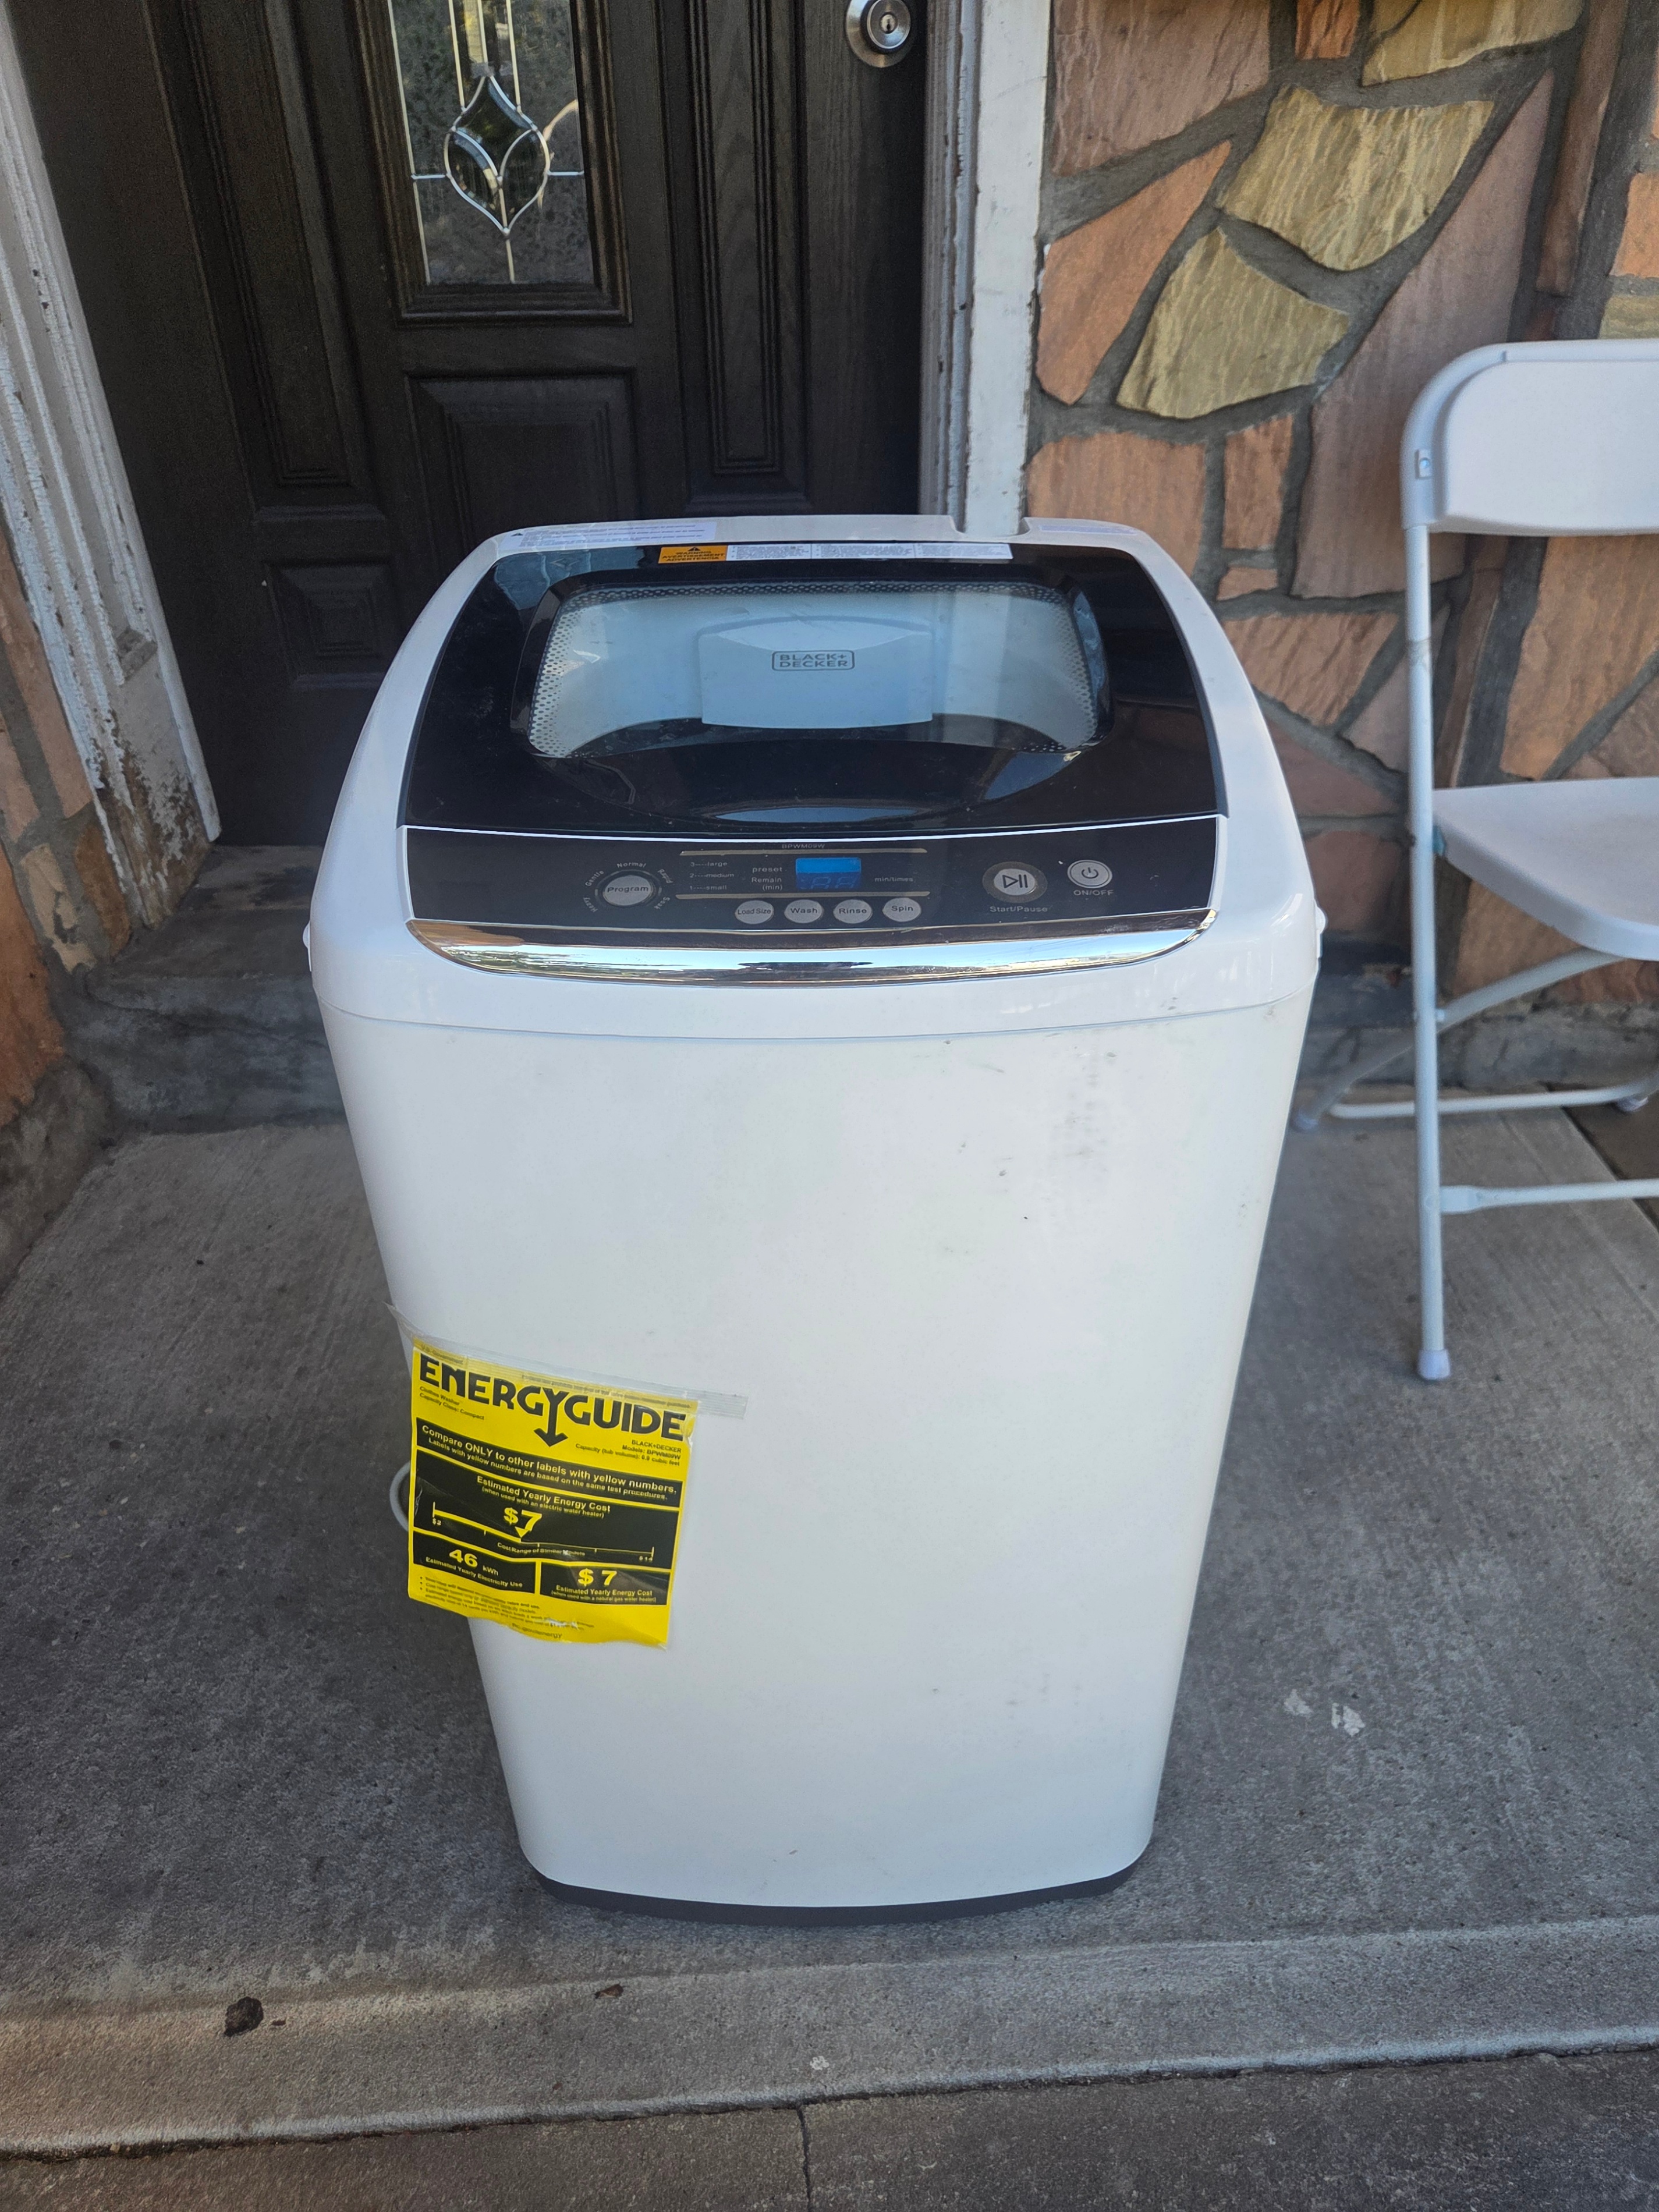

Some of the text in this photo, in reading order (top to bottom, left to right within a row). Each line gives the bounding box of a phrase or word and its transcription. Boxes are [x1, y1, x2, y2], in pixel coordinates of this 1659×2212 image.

[779, 653, 847, 661] BLACK+
[585, 870, 604, 887] Gentle
[654, 896, 670, 909] Soak
[420, 1353, 686, 1446] ENERGYGUIDE
[422, 1425, 463, 1448] Compare
[465, 1442, 493, 1456] ONLY
[495, 1451, 505, 1461] to
[508, 1456, 534, 1467] other
[537, 1461, 566, 1475] labels
[569, 1468, 590, 1480] with
[593, 1473, 626, 1487] yellow
[428, 1437, 450, 1451] Labels
[451, 1447, 466, 1457] with
[467, 1454, 489, 1466] yellow
[491, 1461, 522, 1474] numbers
[523, 1469, 535, 1477] are
[537, 1472, 559, 1482] based
[575, 1443, 600, 1454] Capacity
[622, 1445, 646, 1453] Models:
[477, 1475, 610, 1512] Estimated Yearly Energy Cost
[482, 1486, 499, 1497] (when
[501, 1493, 515, 1501] used
[516, 1497, 529, 1505] with
[540, 1502, 562, 1512] electric
[582, 1510, 604, 1519] heater)
[497, 1542, 511, 1552] Cost
[426, 1557, 456, 1571] Estimated
[458, 1566, 476, 1578] Yearly
[477, 1573, 508, 1587] Electricity
[449, 1549, 499, 1576] 46 kWh
[556, 1584, 588, 1595] Estimated
[612, 1589, 636, 1597] Energy
